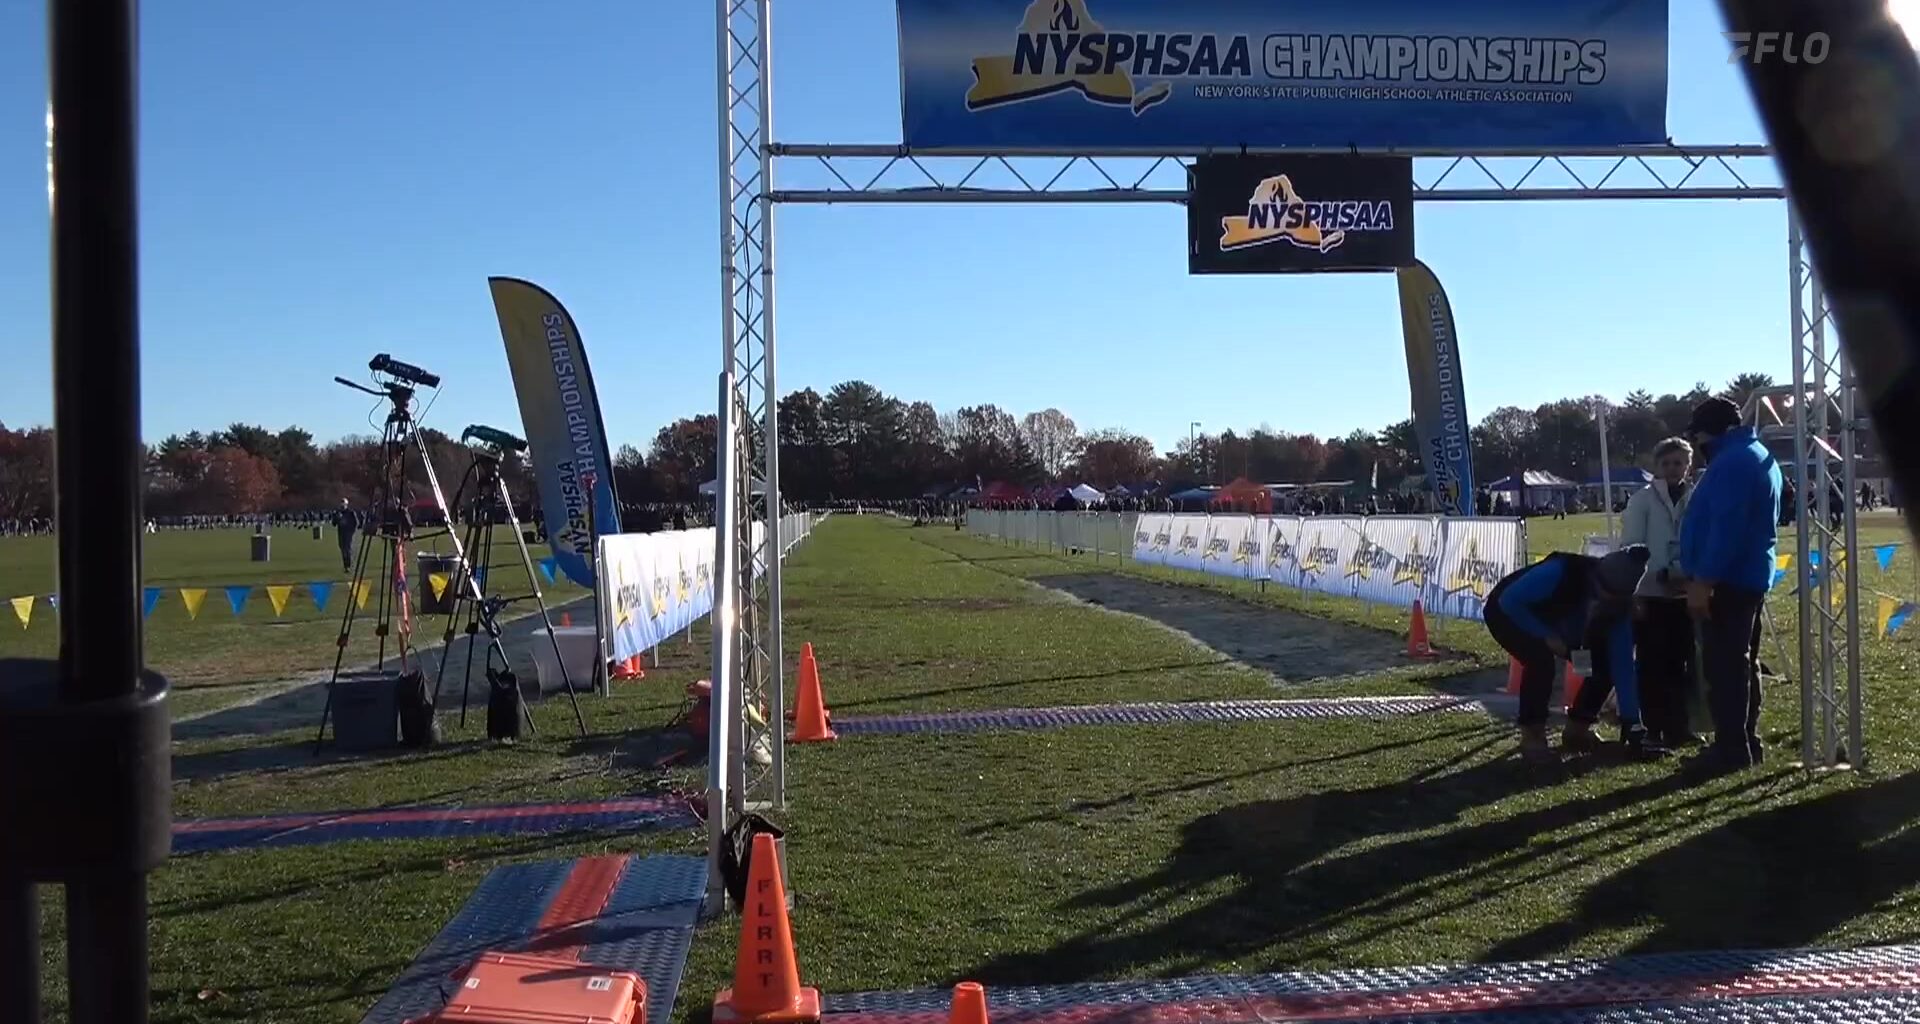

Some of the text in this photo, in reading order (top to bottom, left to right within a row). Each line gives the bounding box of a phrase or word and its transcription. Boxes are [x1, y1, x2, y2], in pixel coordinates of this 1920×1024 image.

[1012, 32, 1606, 85] NYSPHSAA CHAMPIONSHIPS
[1194, 86, 1573, 103] NEW YORK STATE PUBLIC HIGH SCHOOL ATHLETIC ASSOCIATION
[1248, 202, 1394, 230] NYSPHSAA
[1429, 292, 1463, 461] CHAMPIONSHIPS
[557, 460, 592, 554] NYSPHSAA
[757, 879, 775, 987] FLRRT
